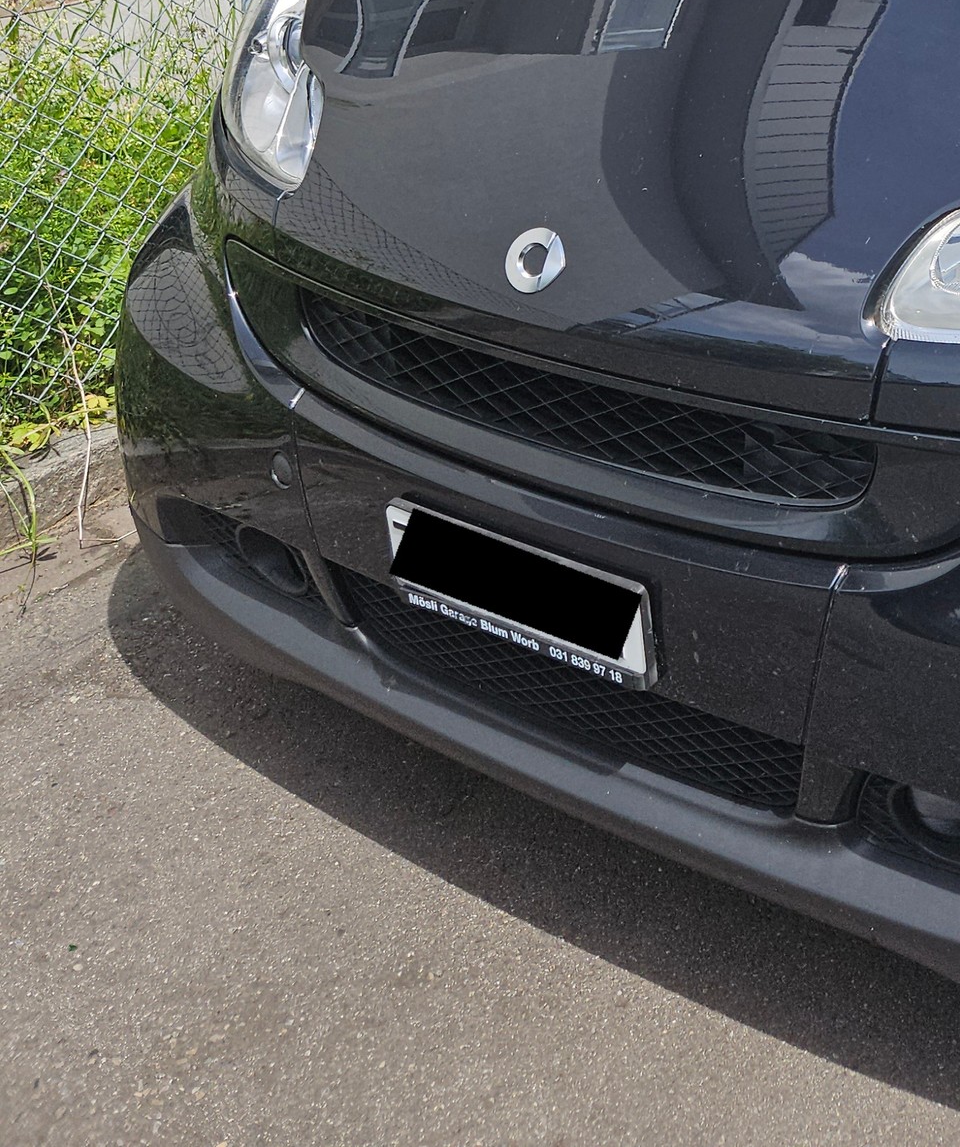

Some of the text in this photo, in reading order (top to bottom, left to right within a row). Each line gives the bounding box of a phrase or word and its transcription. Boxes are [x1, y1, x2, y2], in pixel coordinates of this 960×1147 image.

[408, 592, 438, 612] Mösli
[480, 618, 509, 639] Blum
[510, 630, 540, 651] Worb
[549, 646, 568, 662] 031
[571, 654, 591, 671] 839
[592, 662, 606, 677] 97
[608, 669, 623, 684] 18
